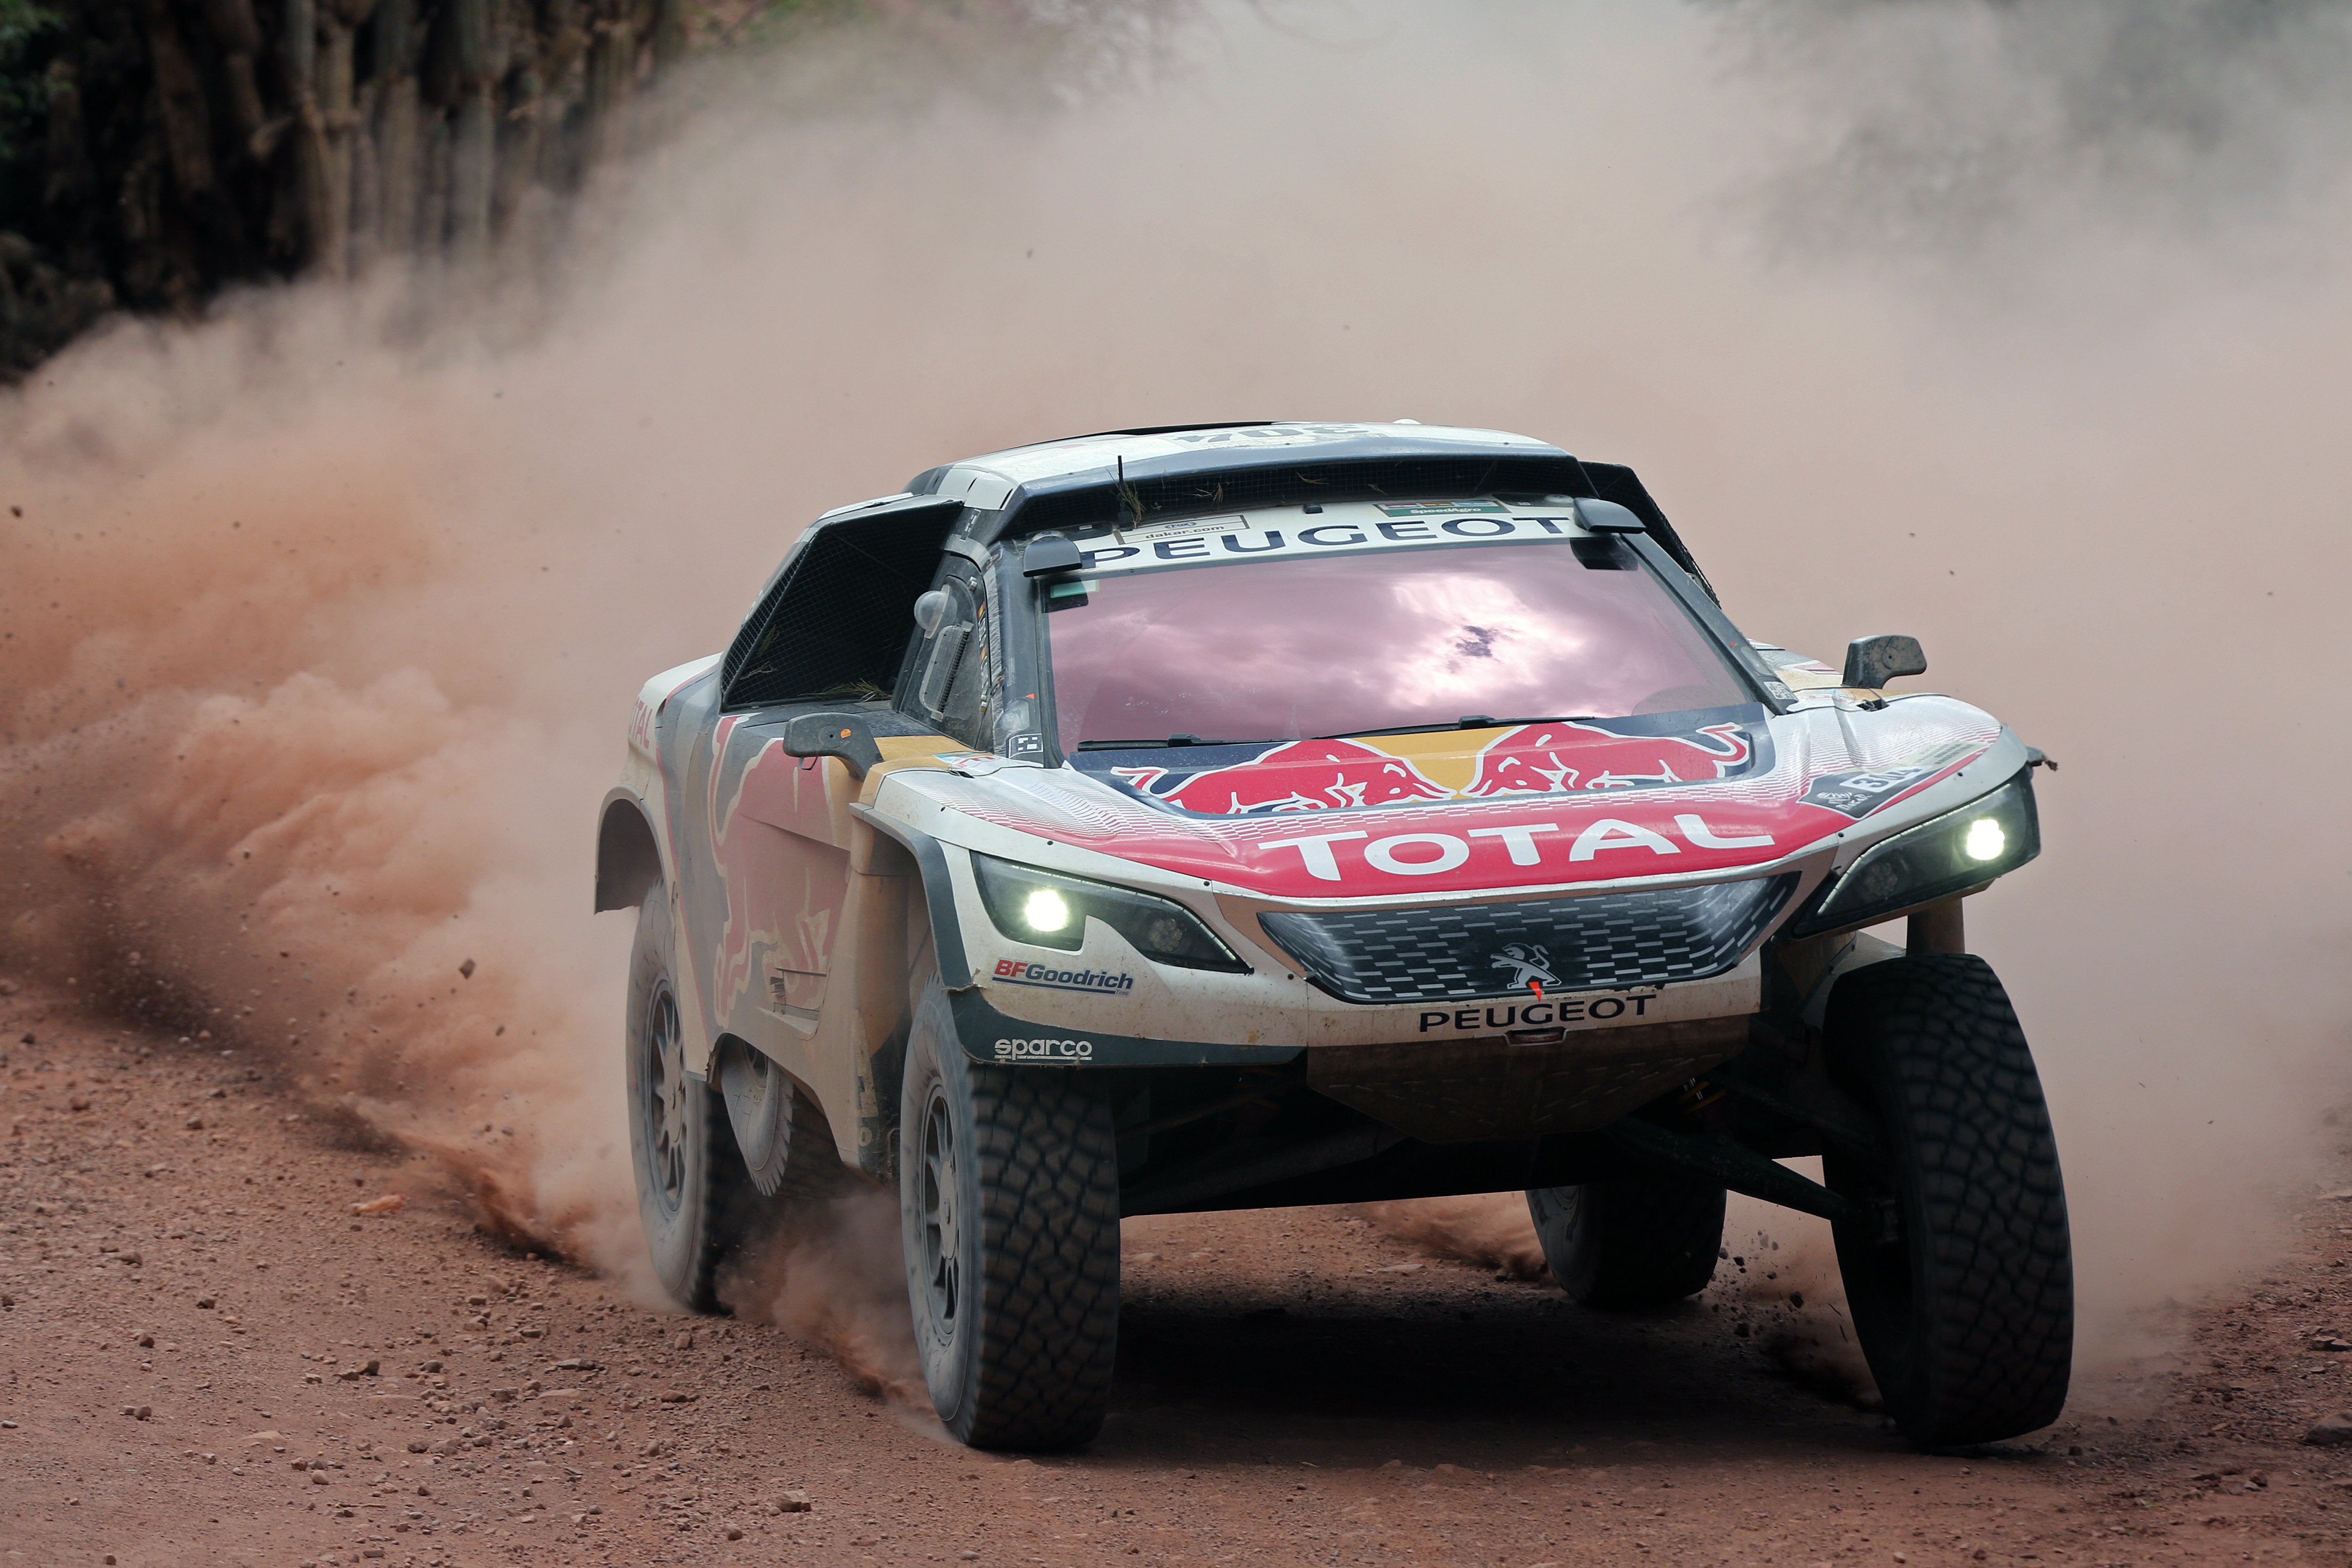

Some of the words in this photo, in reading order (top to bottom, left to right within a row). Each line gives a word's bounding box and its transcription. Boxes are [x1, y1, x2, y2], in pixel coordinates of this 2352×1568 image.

[1079, 516, 1572, 569] PEUGEOT
[1146, 525, 1225, 539] dakar.com
[1852, 767, 1923, 787] 304
[1835, 793, 1874, 810] DAKAR
[1258, 813, 1775, 881] TOTAL
[994, 959, 1134, 990] BFGoodrich
[1419, 994, 1656, 1032] PEUGEOT
[994, 1038, 1093, 1060] sparco
